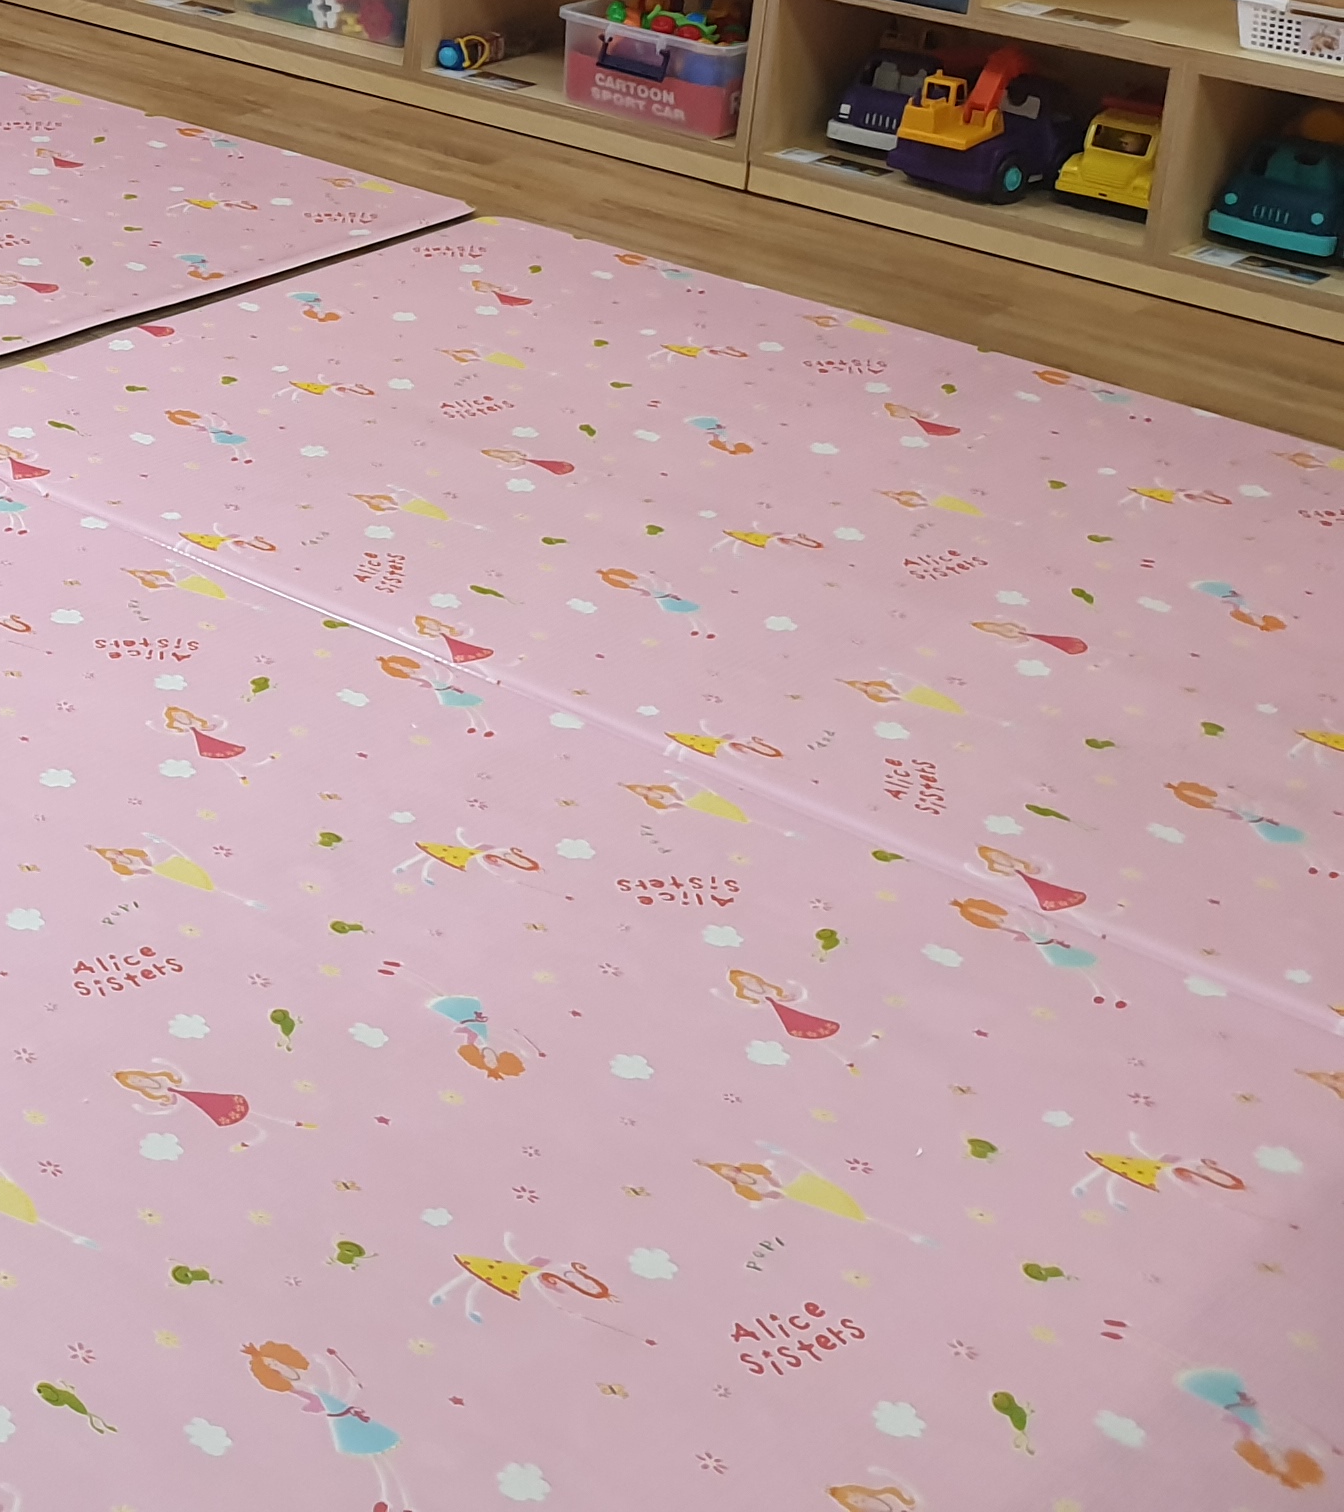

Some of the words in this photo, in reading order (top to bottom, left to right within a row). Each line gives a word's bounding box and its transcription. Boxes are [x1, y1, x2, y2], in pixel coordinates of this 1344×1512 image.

[590, 86, 646, 112] SPORT
[651, 103, 686, 122] CAR
[594, 72, 675, 106] CARTOON
[884, 757, 914, 800] Alice
[72, 946, 157, 974] Alice
[732, 1301, 825, 1342] Alice
